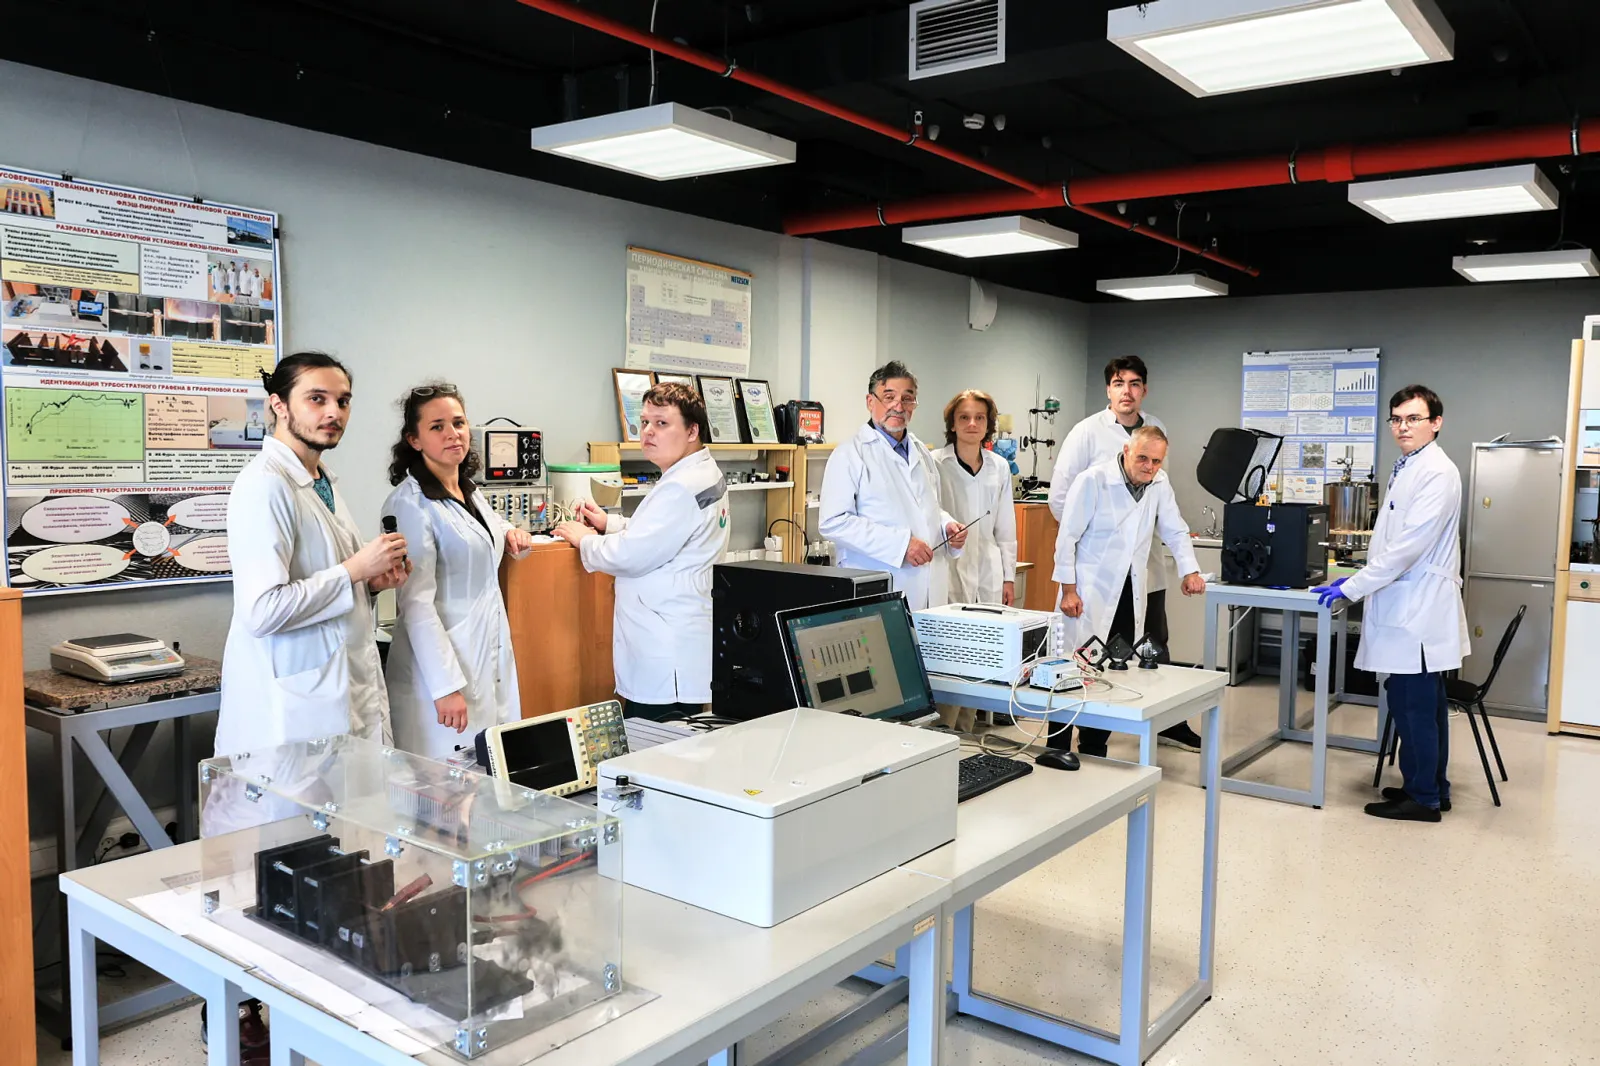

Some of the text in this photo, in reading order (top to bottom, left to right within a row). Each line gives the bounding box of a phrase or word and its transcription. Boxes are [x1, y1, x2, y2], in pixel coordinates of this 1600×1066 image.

[96, 188, 137, 200] УСТАНОВКА
[138, 194, 178, 207] ПОЛУЧЕНИЯ
[179, 202, 222, 214] ГРАФЕНОВОЙ
[223, 208, 241, 218] САЖИ
[242, 211, 271, 223] МЕТОДОМ
[116, 199, 175, 214] ФЛЭШ-ПИРОЛИЗА
[55, 223, 238, 255] РАЗРАБОТКА ЛАБОРАТОРНОЙ УСТАНОВКИ ФЛЭШ-ПИРОЛИЗА
[631, 252, 729, 281] ПЕРИОДИЧЕСКАЯ СИСТЕМА
[40, 378, 99, 388] ИДЕНТИФИКАЦИЯ
[100, 381, 157, 390] ТУРБОСТРАТНОГО
[158, 383, 186, 391] ГРАФЕНА
[192, 384, 231, 393] ГРАФЕНОВОЙ
[232, 386, 248, 394] САЖЕ
[49, 487, 94, 495] ПРИМЕНЕНИЕ
[95, 486, 151, 494] ТУРБОСТРАТНОГО
[187, 485, 227, 493] ГРАФЕНОВОЙ
